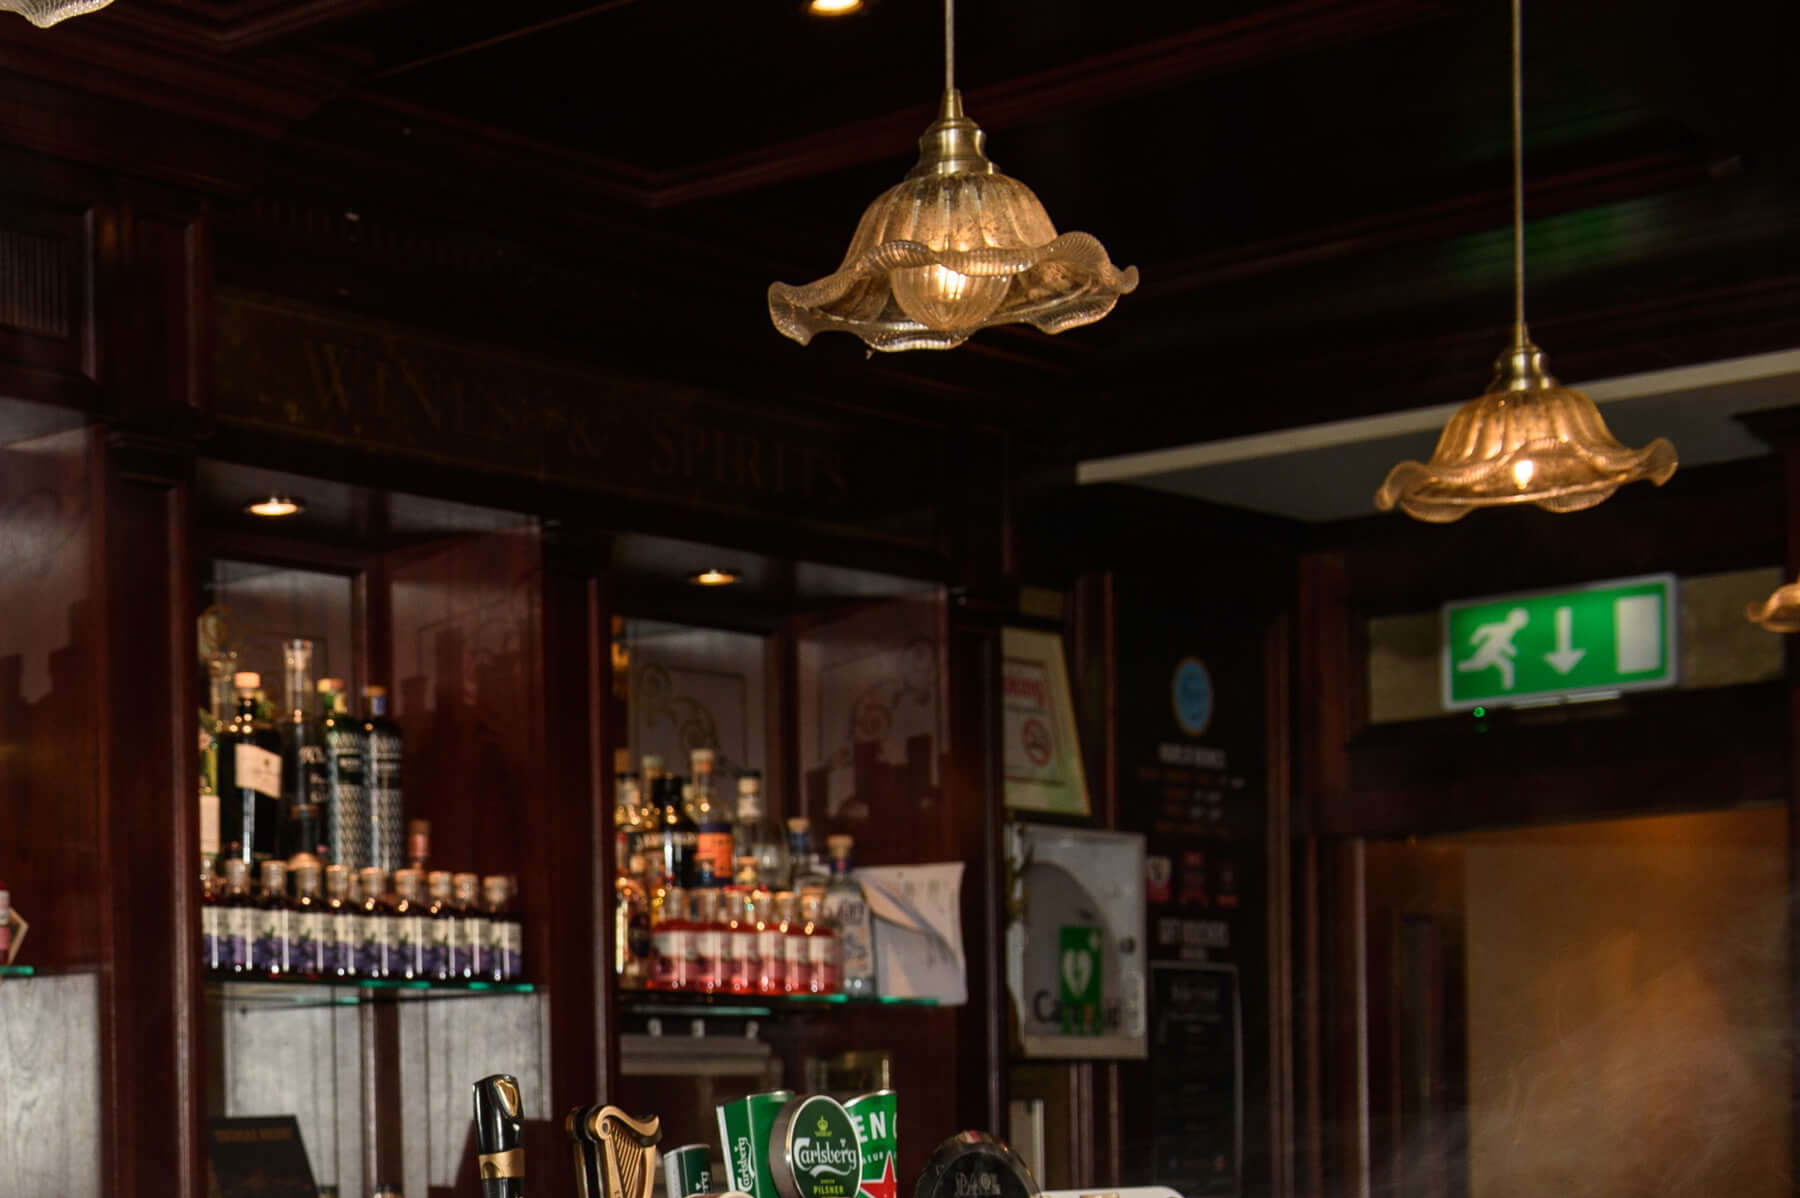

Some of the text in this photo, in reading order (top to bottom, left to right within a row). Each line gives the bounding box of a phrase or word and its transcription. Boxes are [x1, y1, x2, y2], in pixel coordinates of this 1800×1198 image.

[731, 1136, 756, 1193] Carlsberg
[793, 1137, 858, 1178] Carlsberg
[813, 1184, 845, 1196] PILSNER
